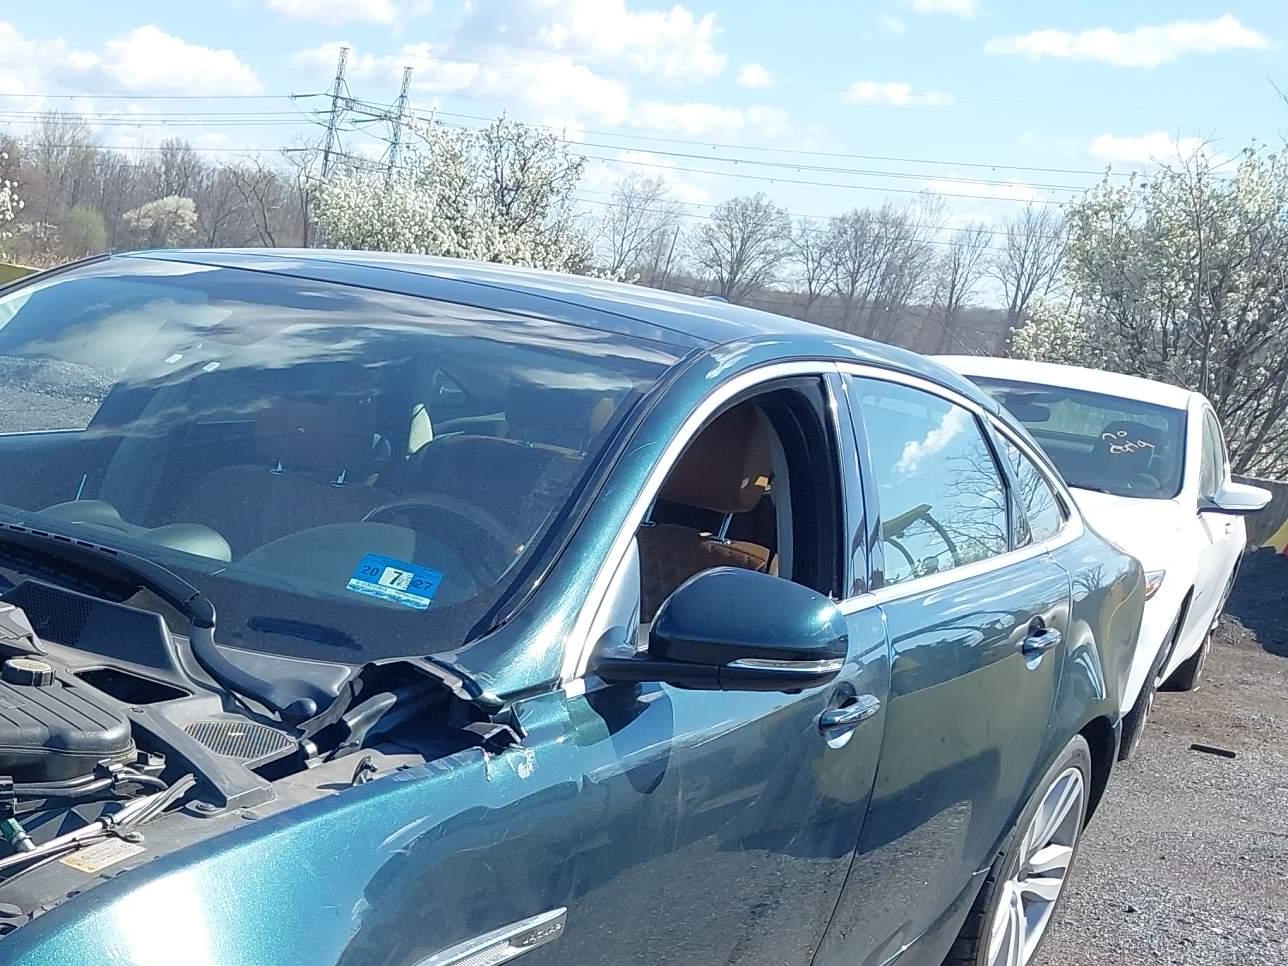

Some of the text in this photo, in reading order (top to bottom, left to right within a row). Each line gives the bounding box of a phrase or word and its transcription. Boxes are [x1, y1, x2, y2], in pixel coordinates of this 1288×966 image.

[360, 565, 432, 591] 20 7 27
